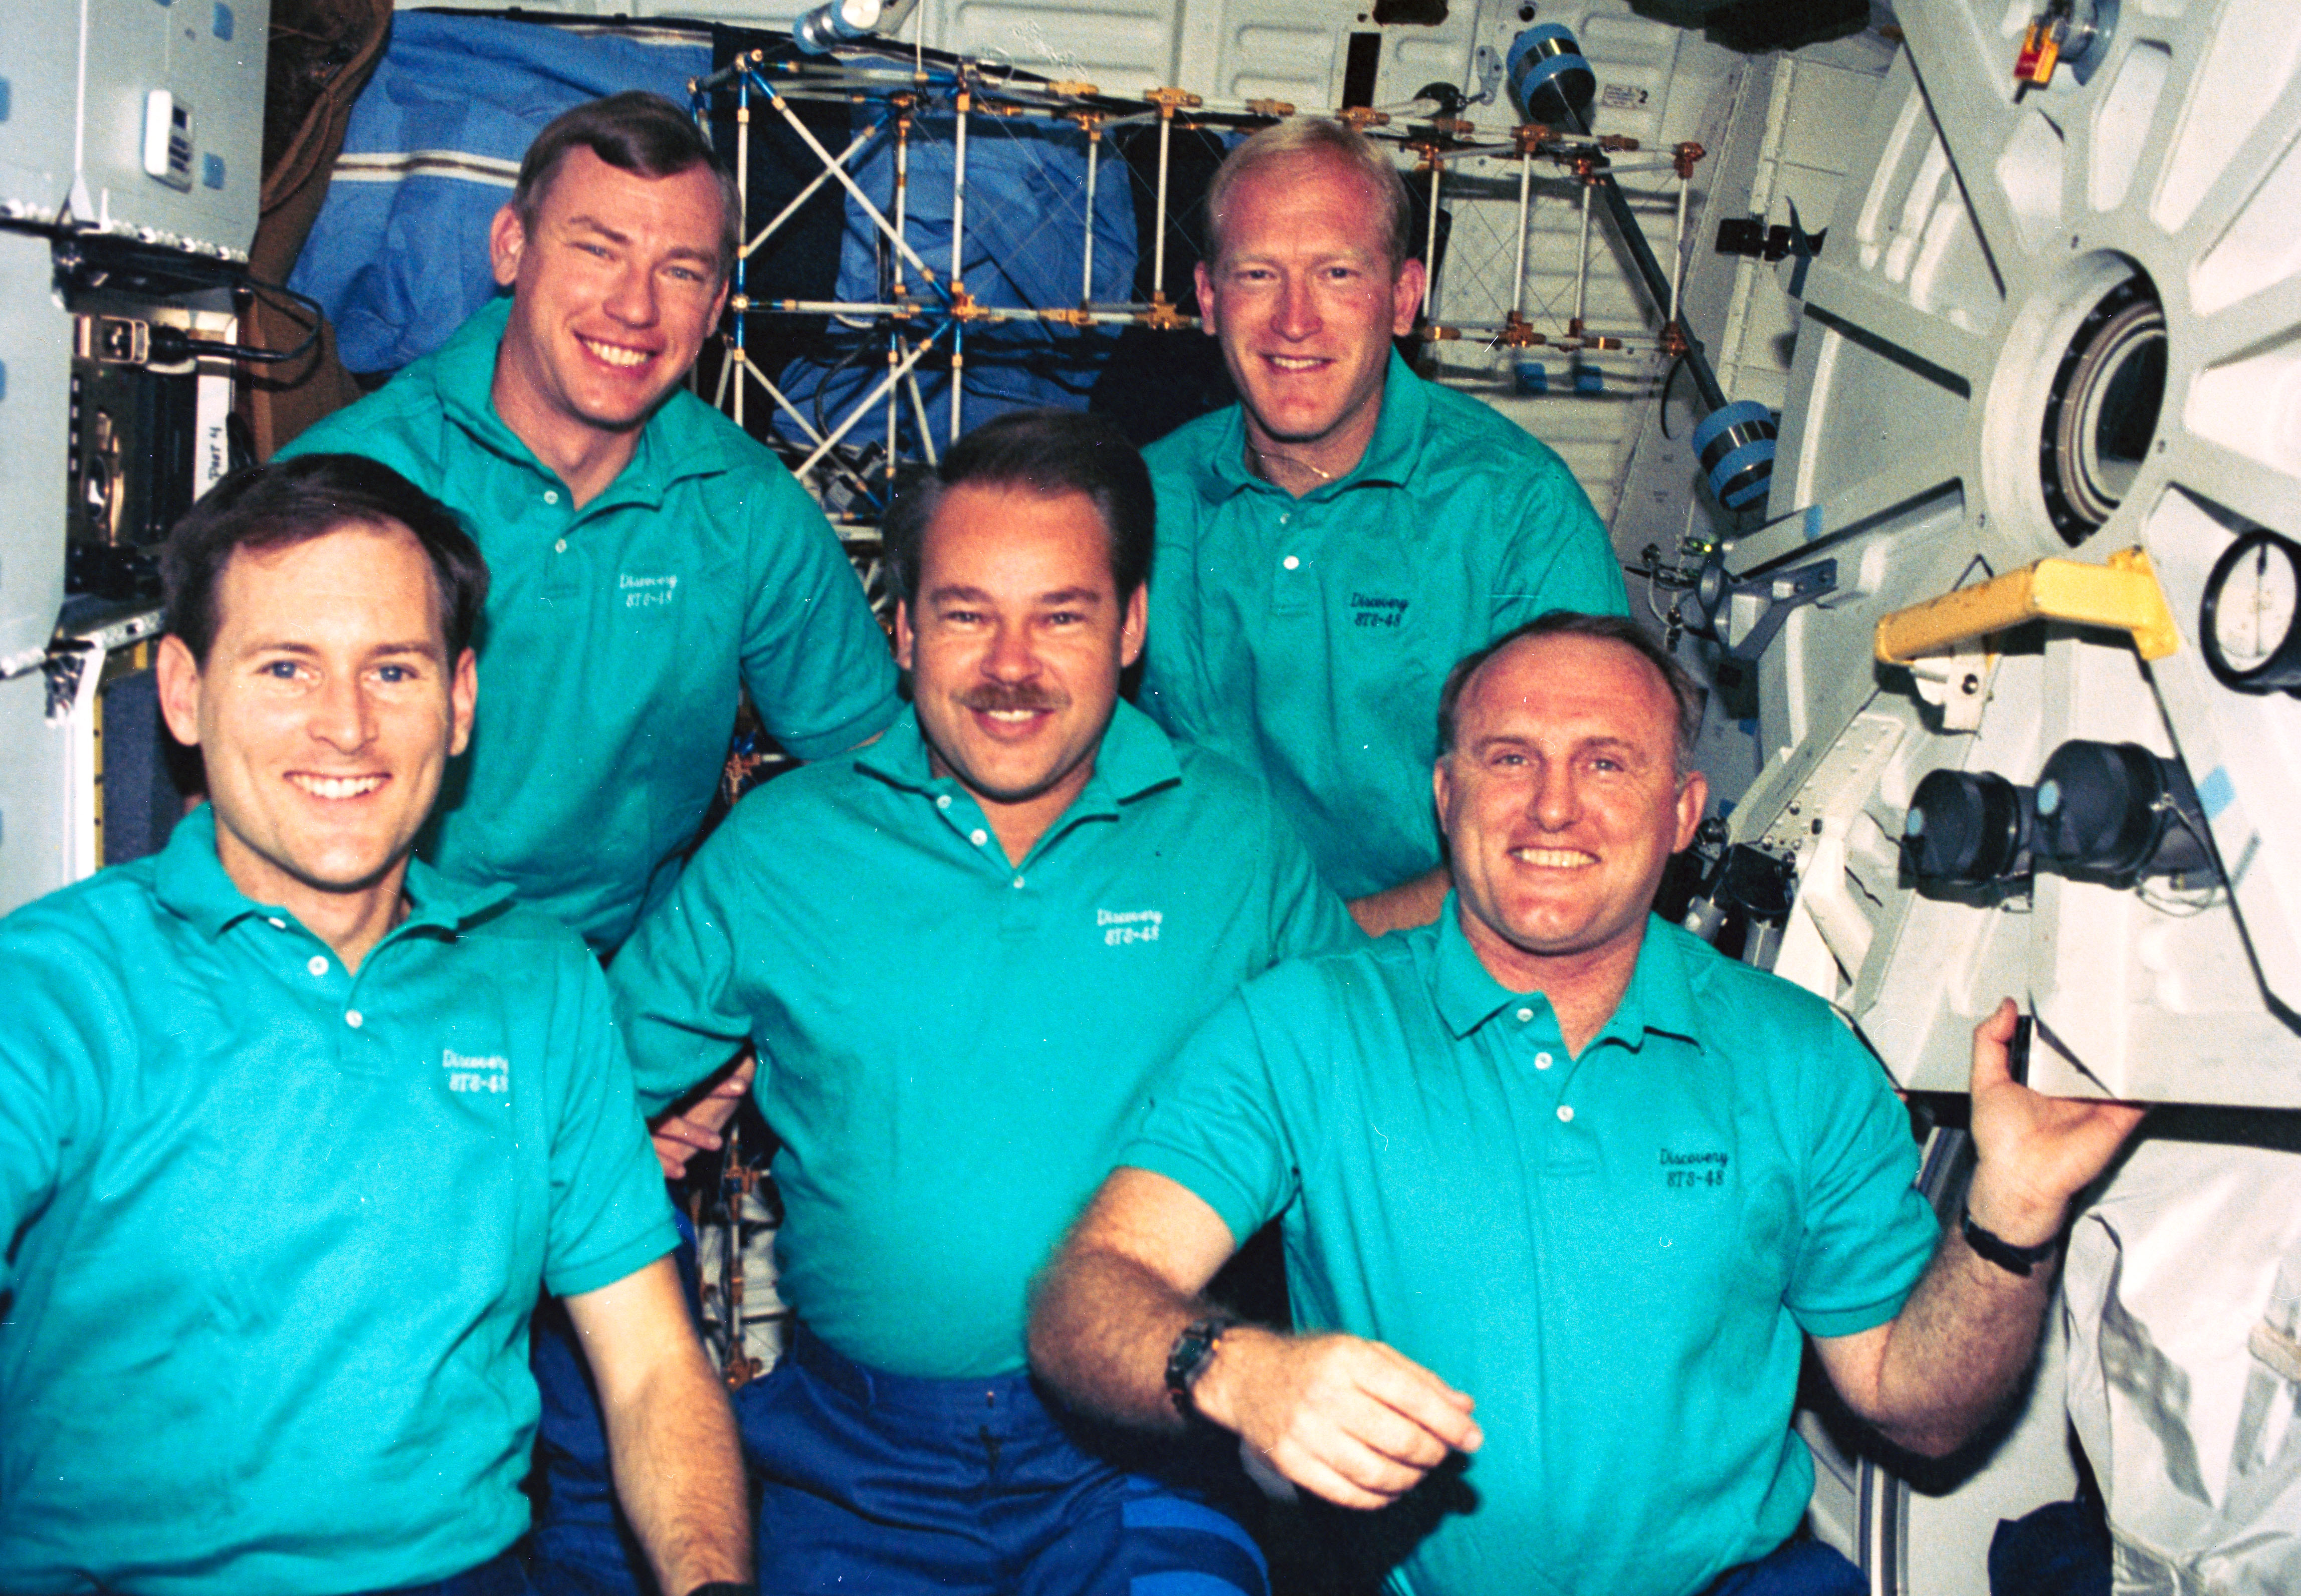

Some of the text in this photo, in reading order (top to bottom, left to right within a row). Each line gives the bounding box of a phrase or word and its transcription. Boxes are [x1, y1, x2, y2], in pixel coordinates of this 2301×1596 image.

[1351, 592, 1409, 613] Discovery
[1097, 908, 1163, 926] Discovery
[443, 1049, 509, 1075] Discovery
[1660, 1148, 1728, 1168] Discovery
